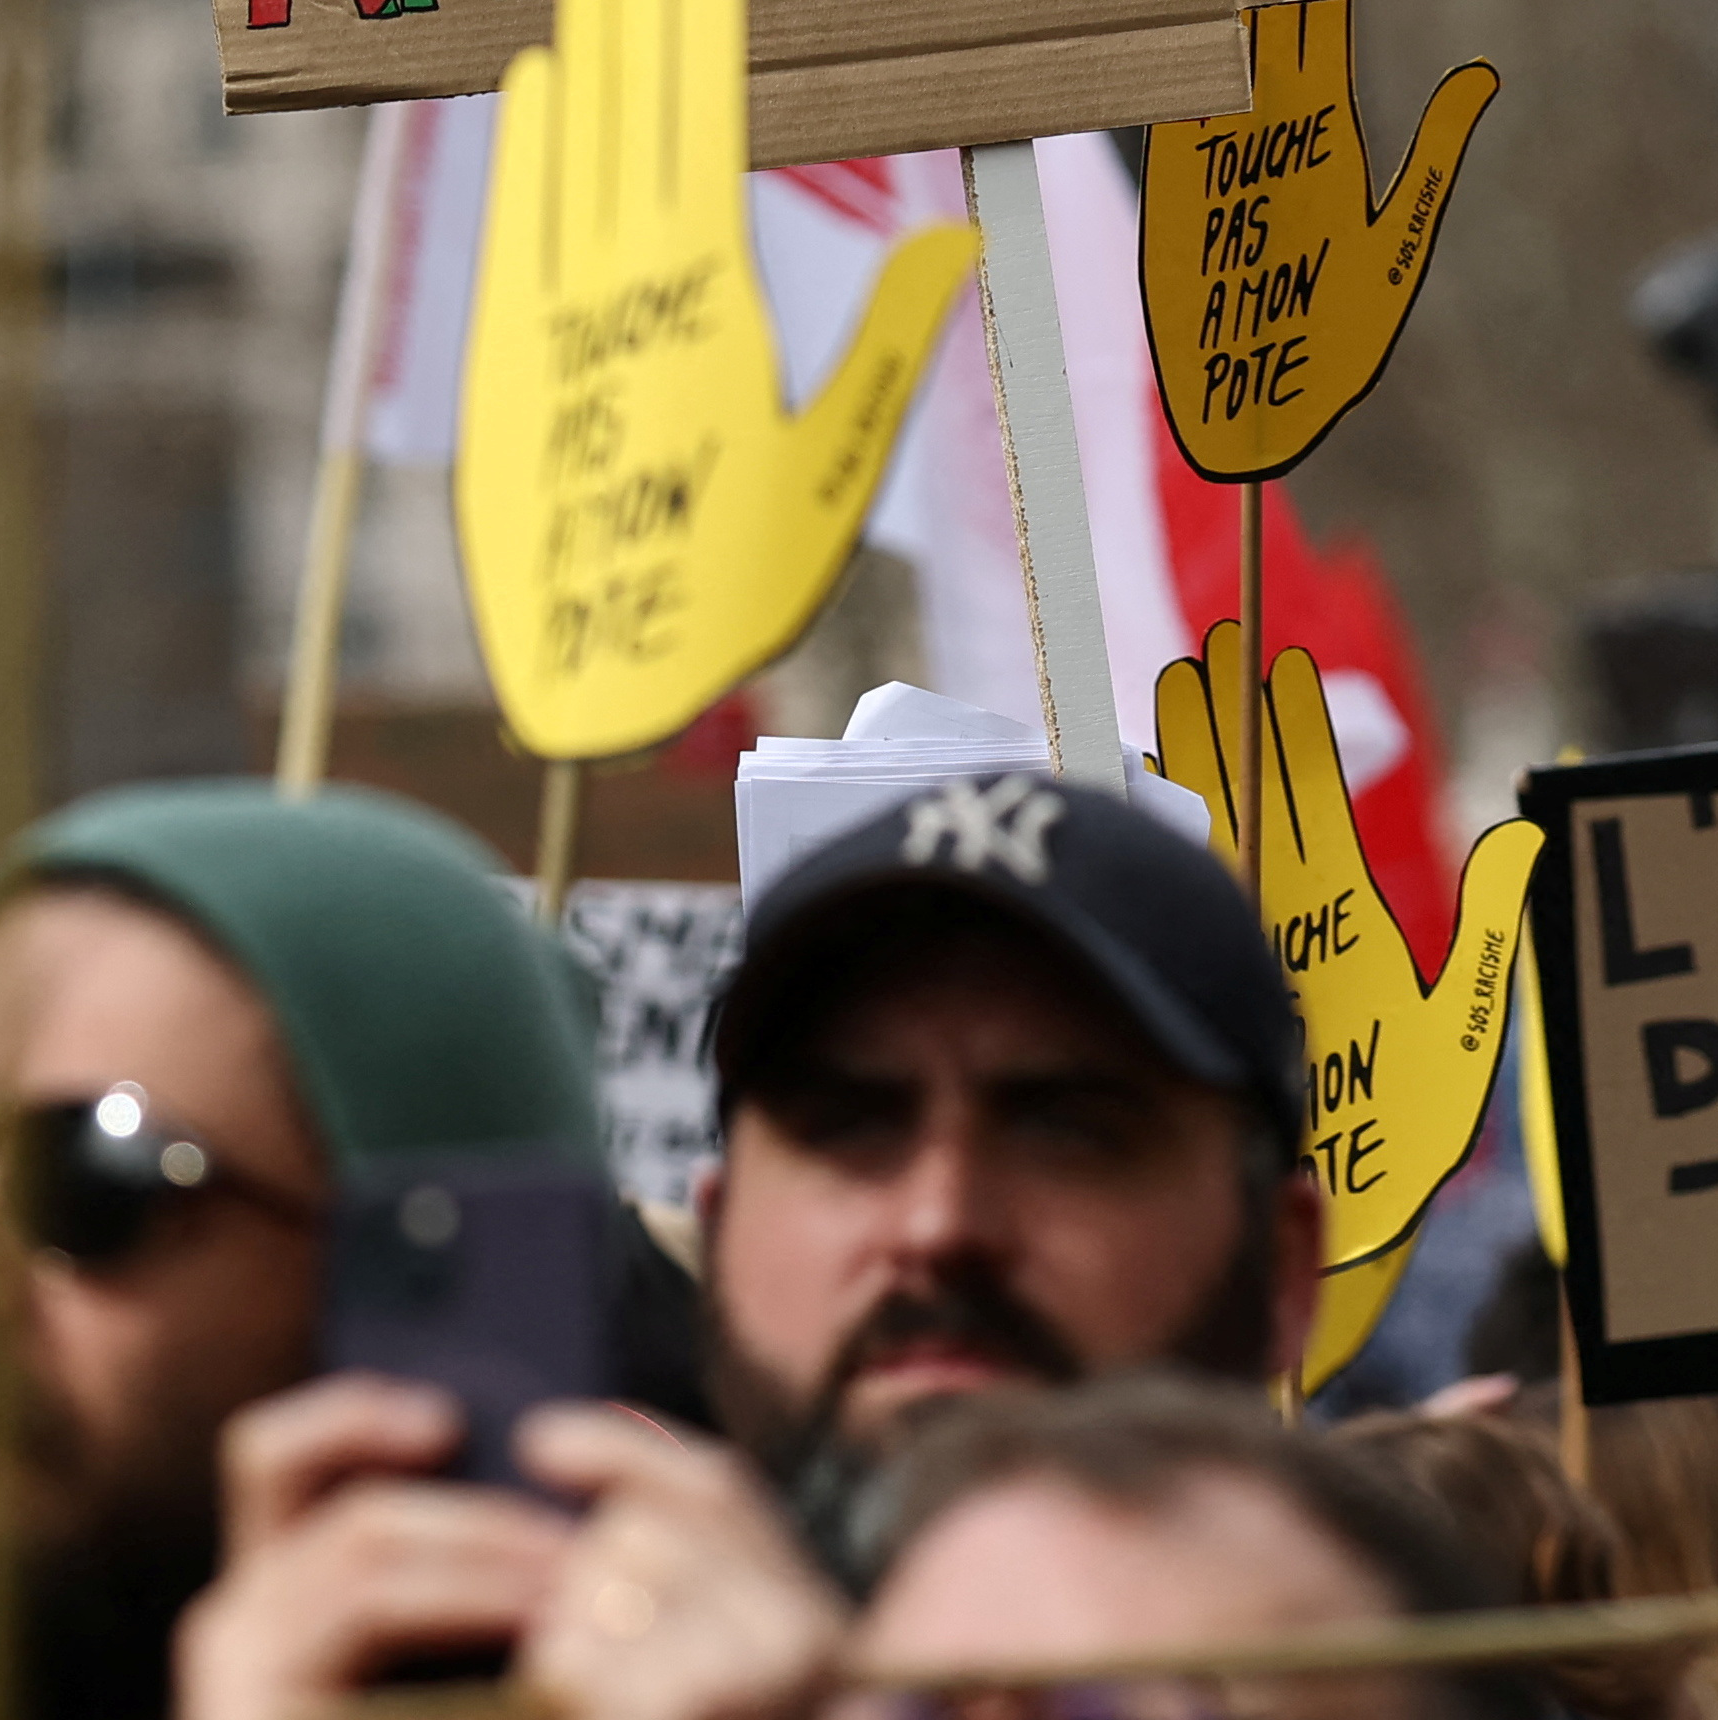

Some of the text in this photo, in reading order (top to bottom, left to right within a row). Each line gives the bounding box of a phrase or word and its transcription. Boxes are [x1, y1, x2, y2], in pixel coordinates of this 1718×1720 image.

[1196, 105, 1335, 199] TOUCHE
[1201, 195, 1270, 276] PAS
[1200, 238, 1329, 349] A MON
[1203, 336, 1309, 424] POTE
